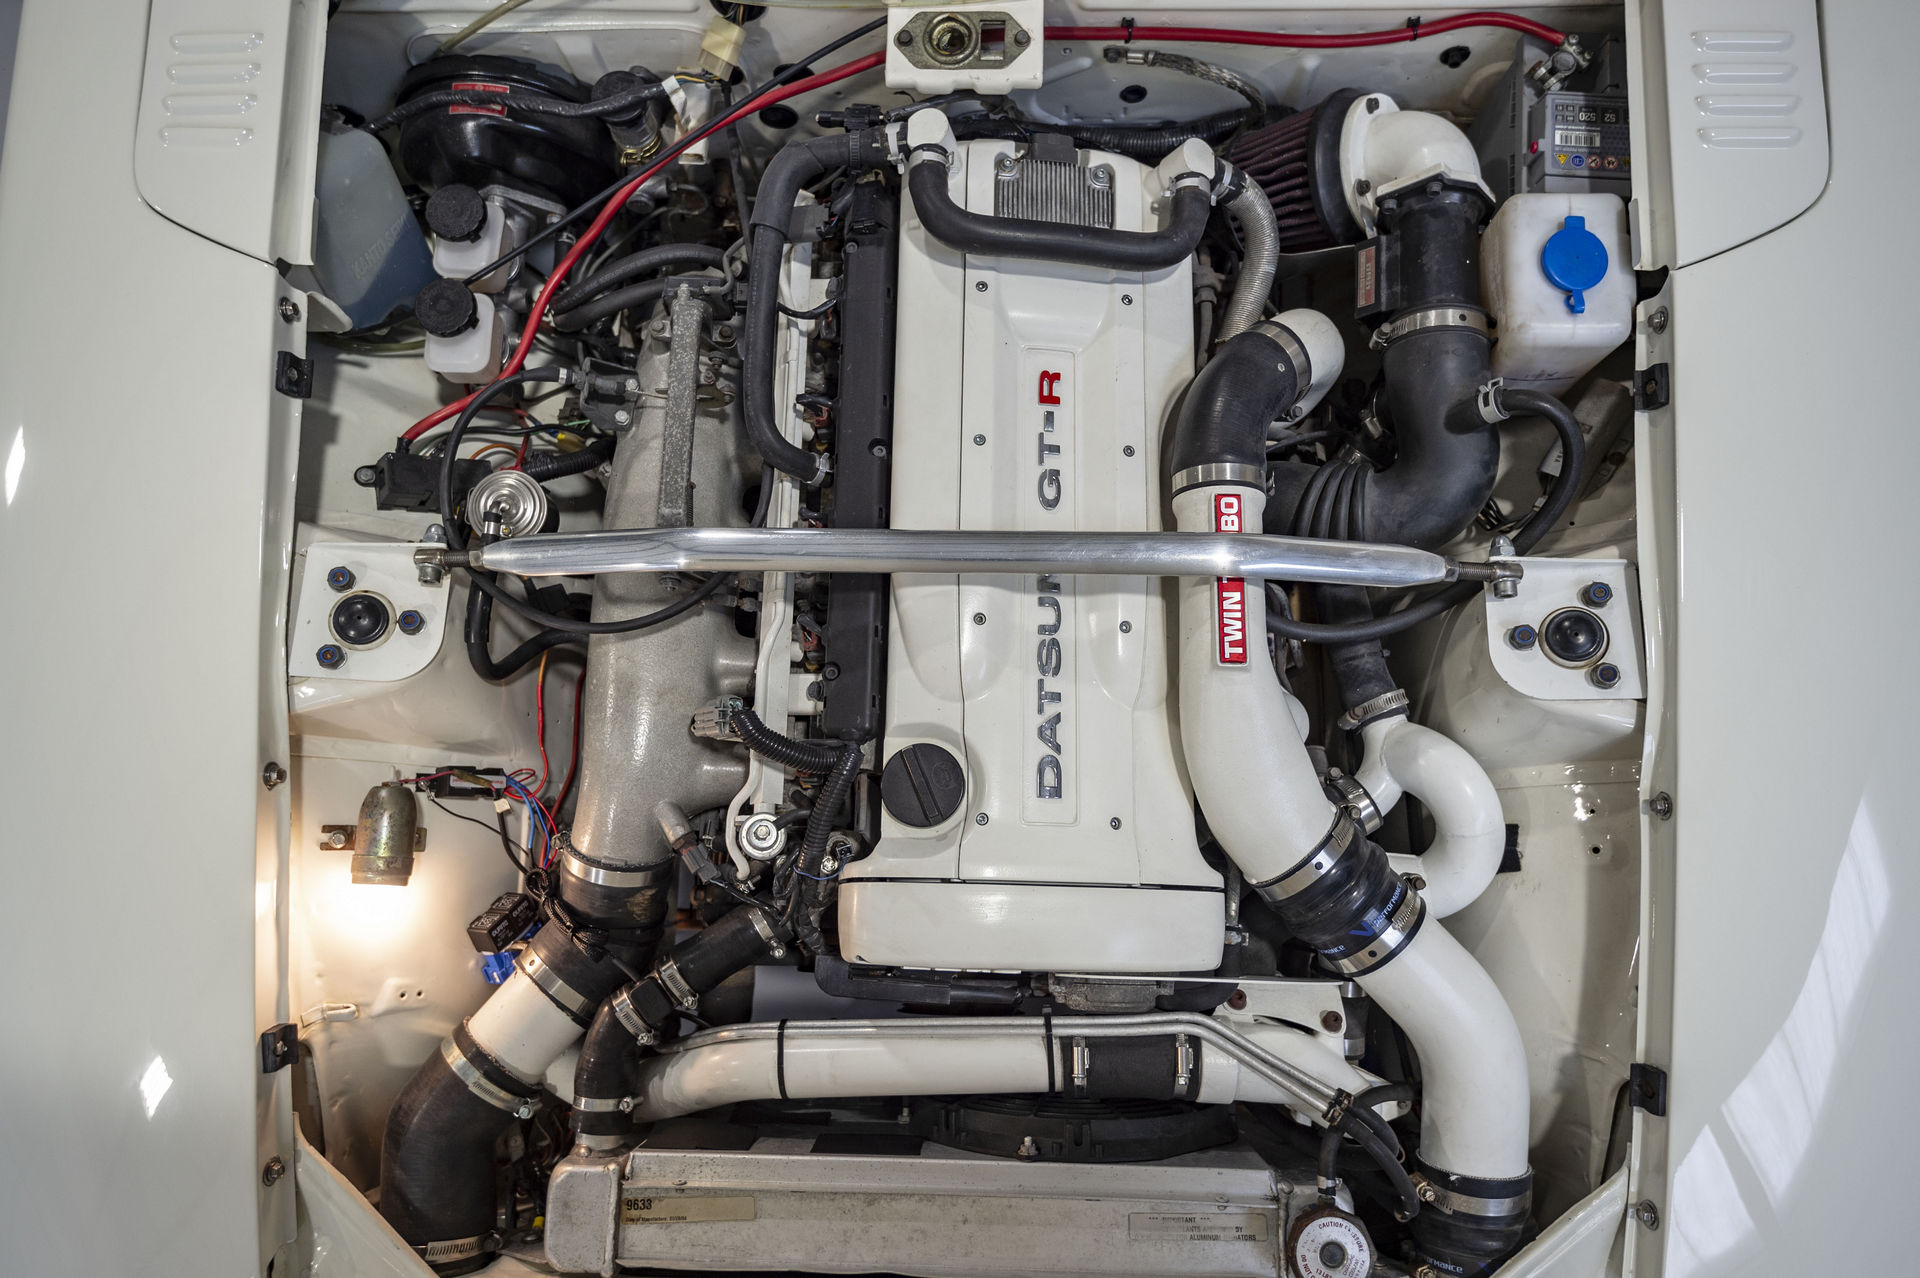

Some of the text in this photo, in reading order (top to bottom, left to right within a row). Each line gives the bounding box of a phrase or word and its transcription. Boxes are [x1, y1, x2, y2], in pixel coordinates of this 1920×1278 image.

[1578, 112, 1597, 122] 520
[1038, 370, 1062, 511] GT-R
[1222, 591, 1244, 659] TWIN
[626, 1198, 653, 1211] 9633
[1318, 1221, 1344, 1230] CAUTION
[1302, 1263, 1312, 1276] NOT
